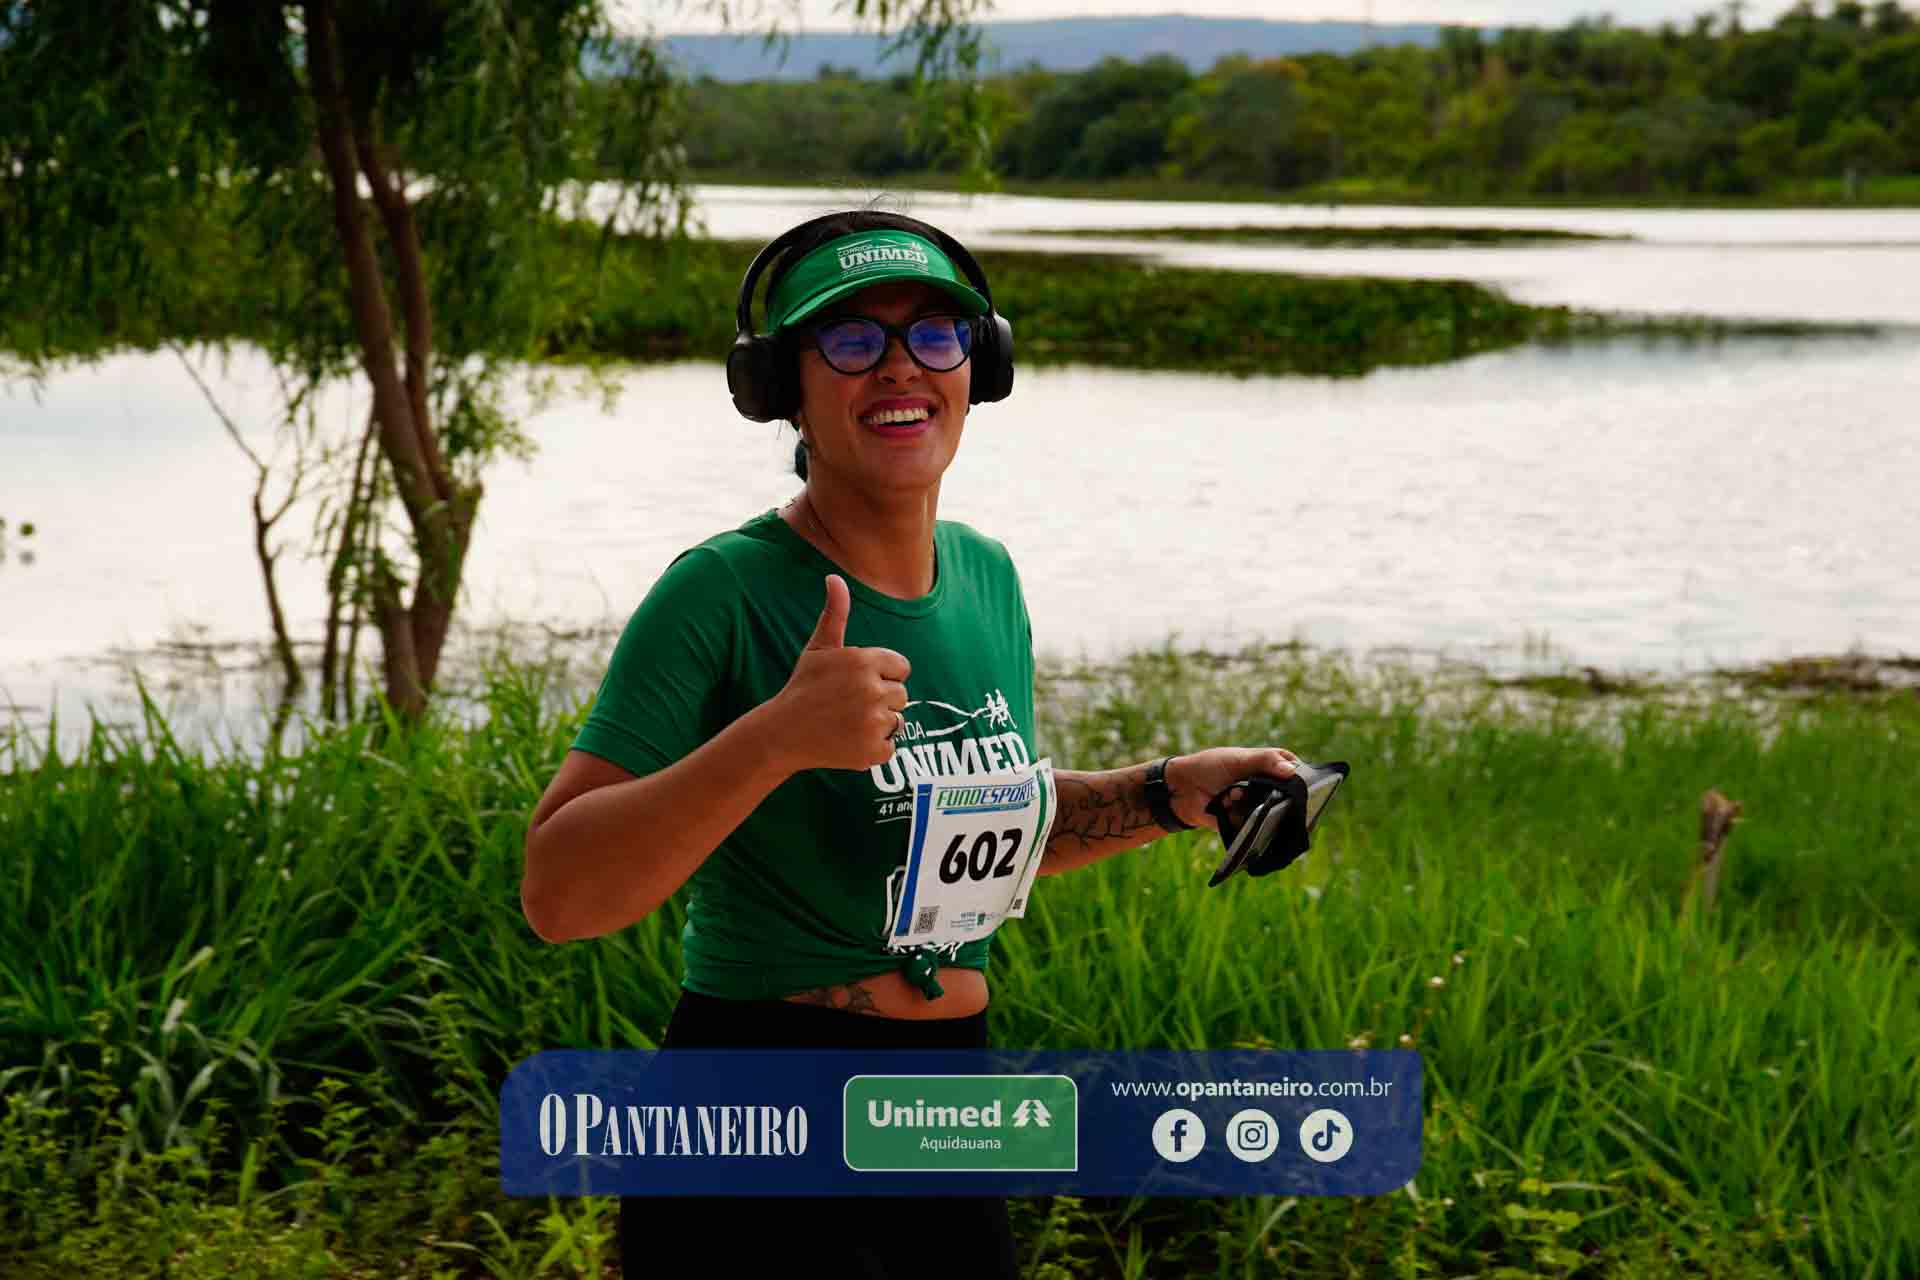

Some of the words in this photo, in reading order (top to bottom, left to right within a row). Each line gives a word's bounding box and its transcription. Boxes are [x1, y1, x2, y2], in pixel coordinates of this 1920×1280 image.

[840, 247, 928, 270] UNIMED
[870, 731, 1031, 793] UNIMED
[879, 802, 894, 816] 41
[939, 828, 1023, 884] 602
